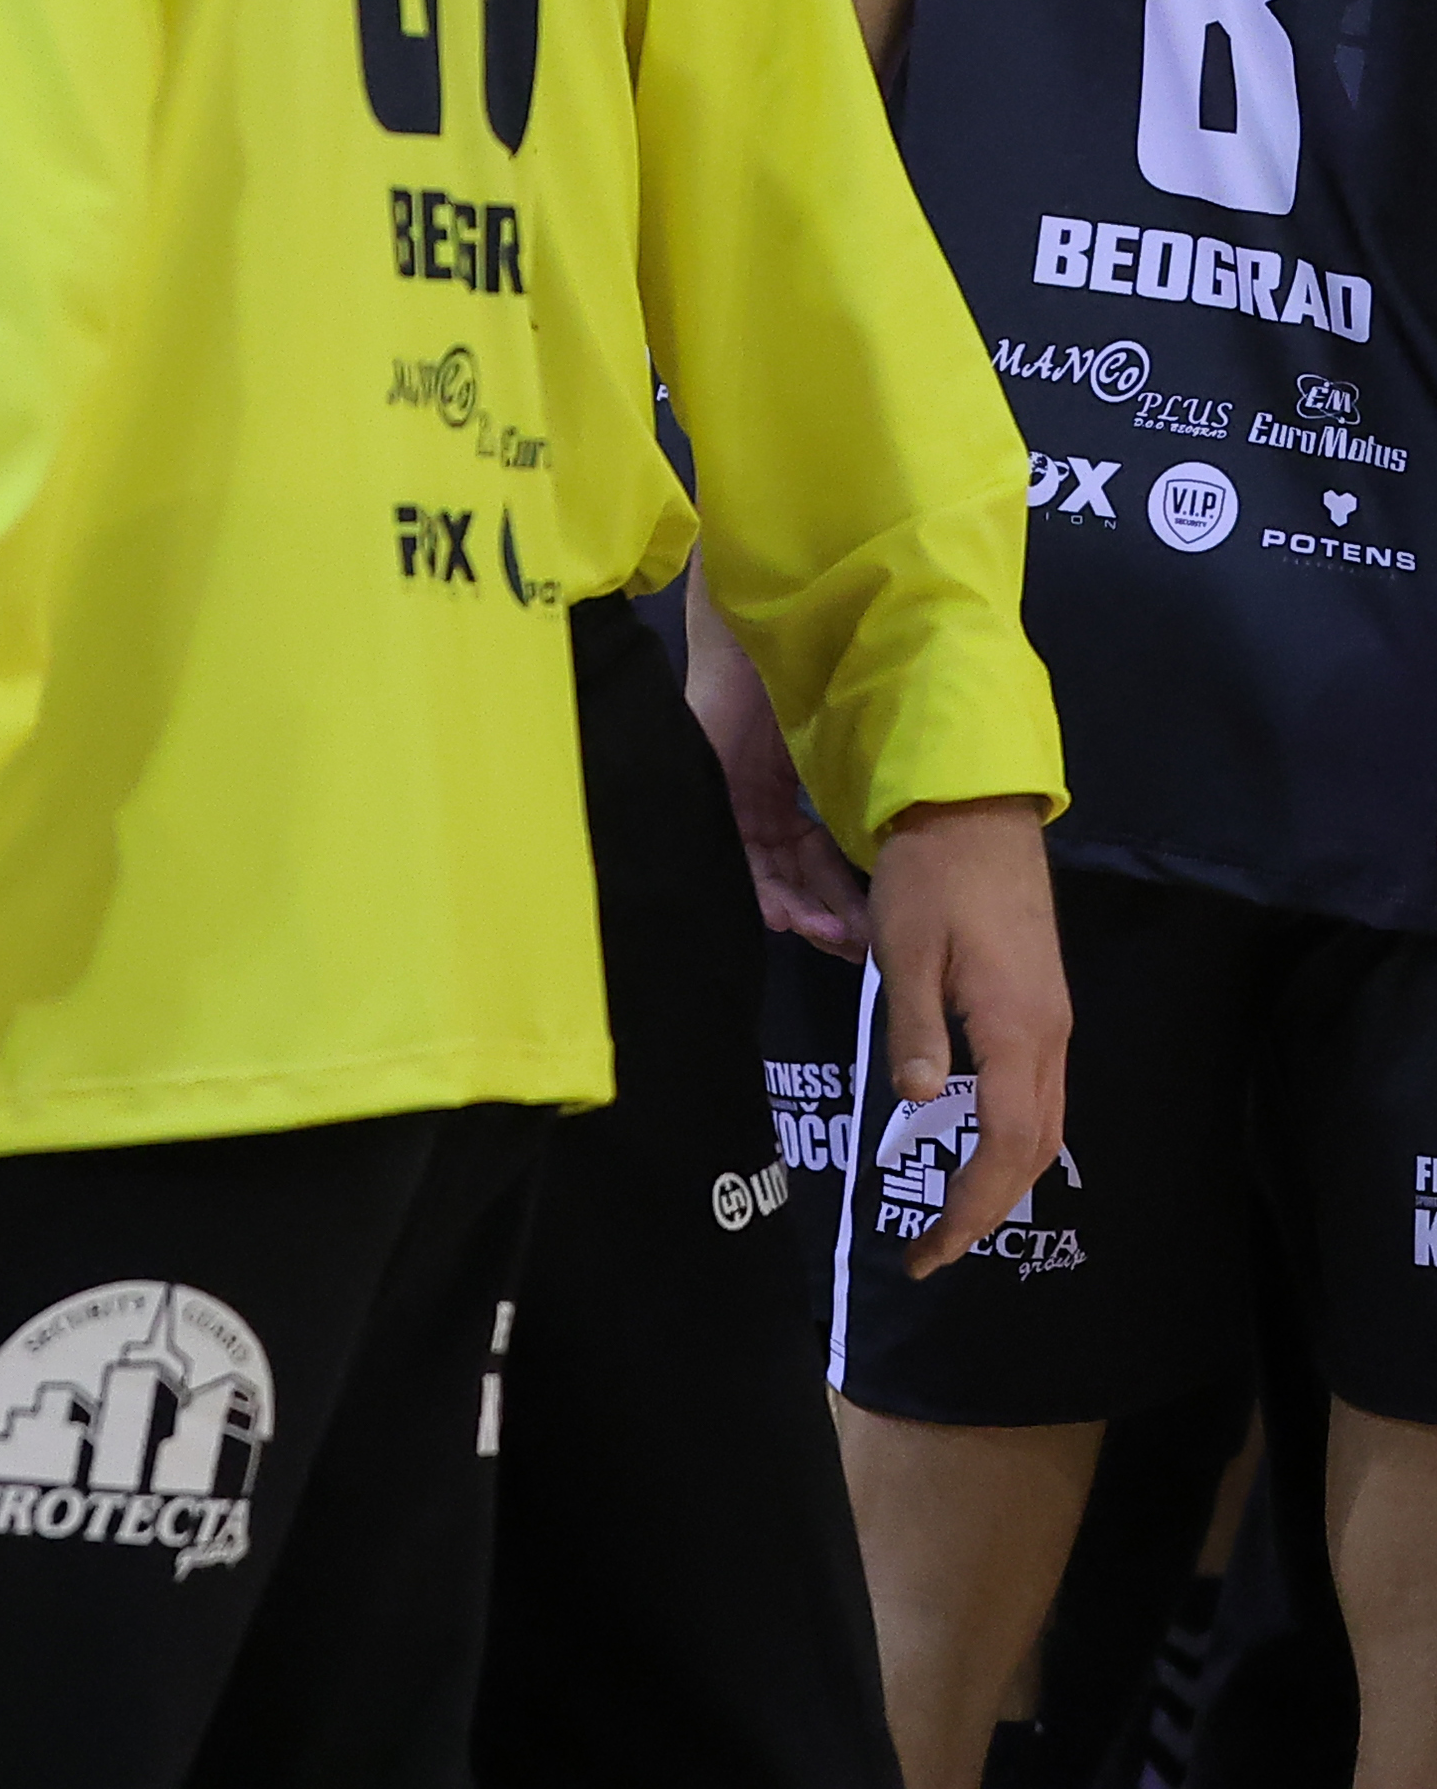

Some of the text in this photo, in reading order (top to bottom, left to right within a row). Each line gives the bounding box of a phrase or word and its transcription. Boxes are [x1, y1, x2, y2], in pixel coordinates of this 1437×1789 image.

[1033, 215, 1372, 343] BEOGRAD
[1136, 392, 1233, 428] PLUS
[1262, 528, 1416, 571] POTENS
